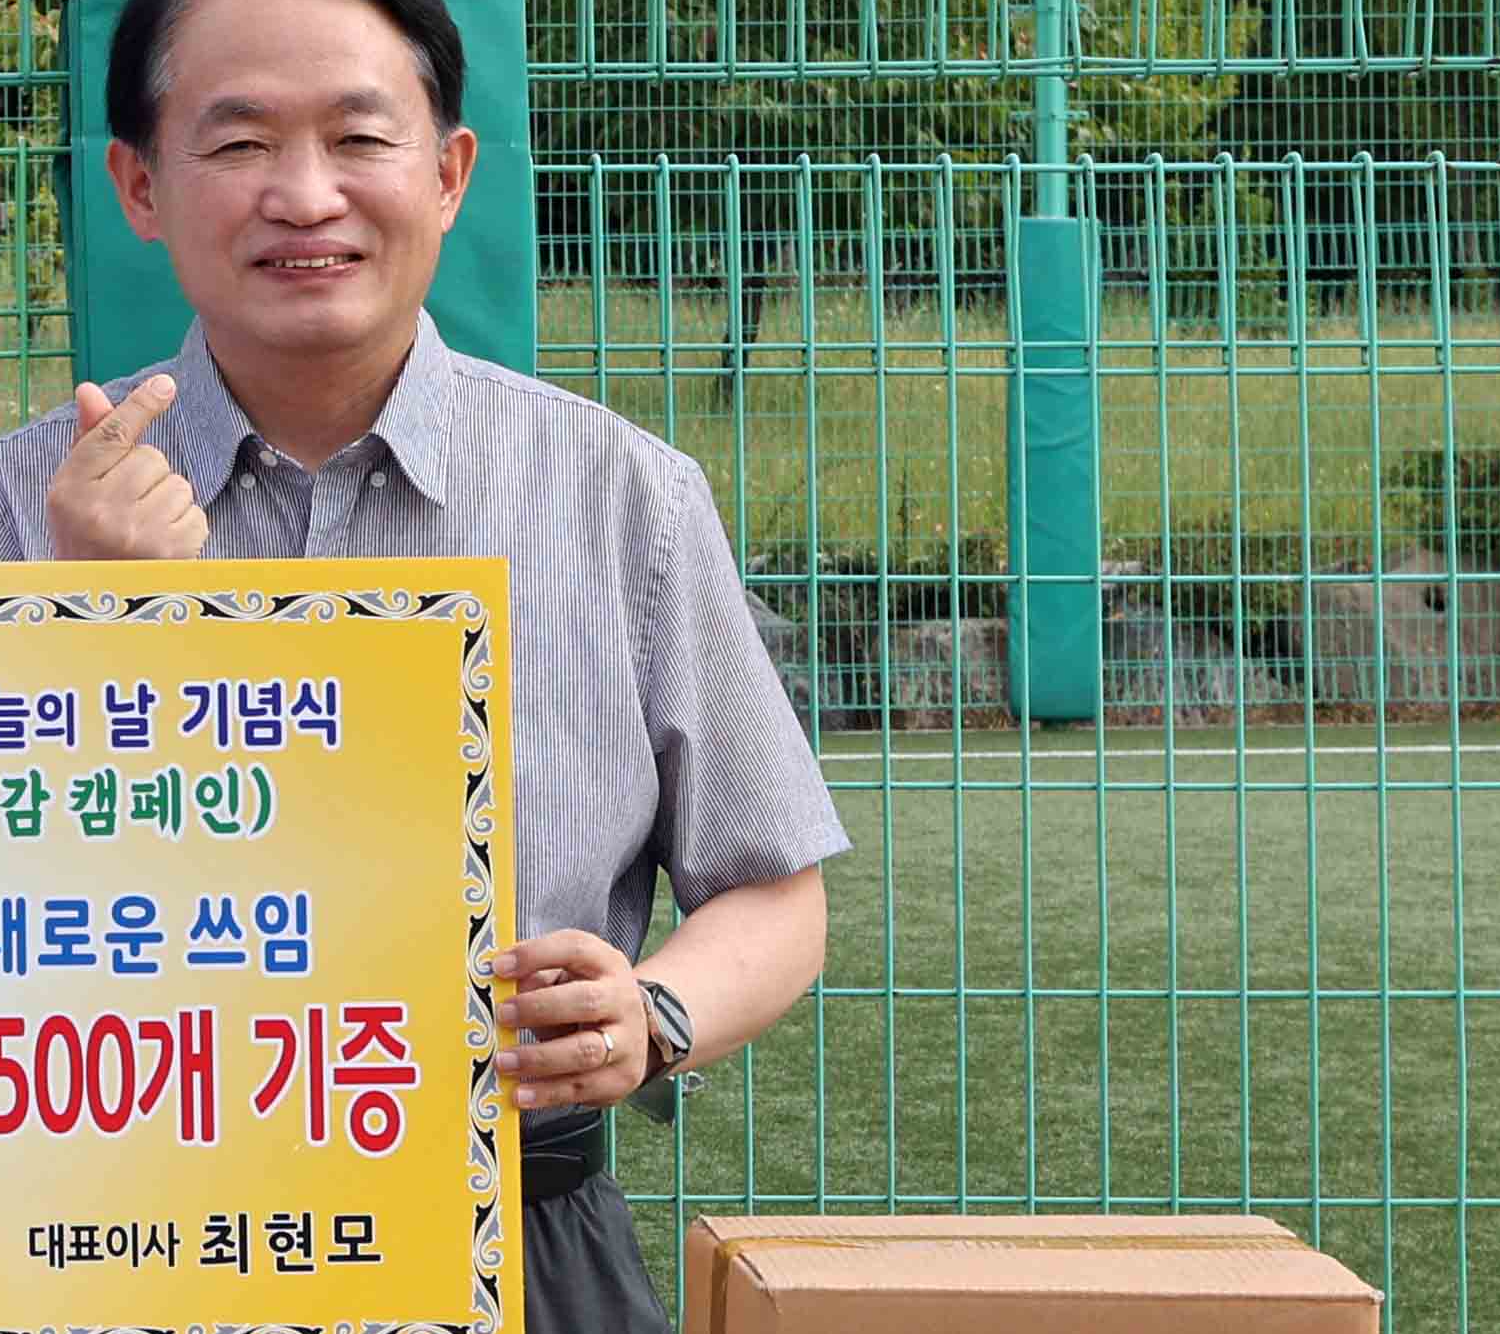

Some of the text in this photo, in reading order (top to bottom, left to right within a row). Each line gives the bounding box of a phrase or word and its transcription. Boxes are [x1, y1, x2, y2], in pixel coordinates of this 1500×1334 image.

[107, 684, 155, 747] 날
[184, 683, 336, 746] 기념식
[73, 769, 269, 835] 캠페인)
[188, 895, 307, 971] 쓰임
[256, 1007, 415, 1151] 기증
[30, 1223, 180, 1268] 대표이사
